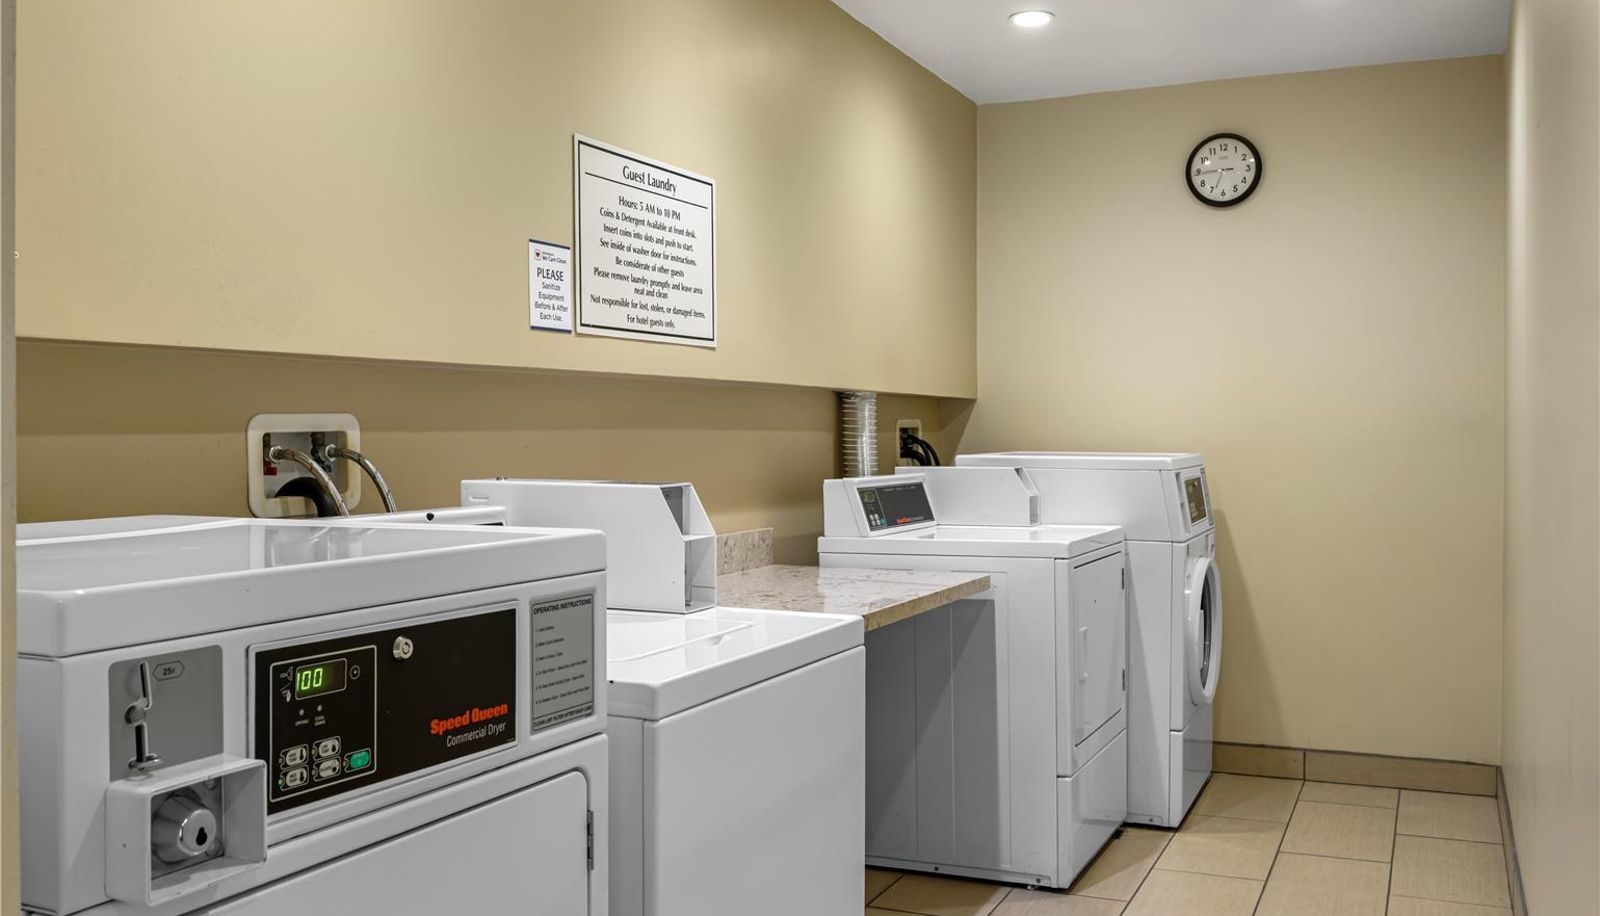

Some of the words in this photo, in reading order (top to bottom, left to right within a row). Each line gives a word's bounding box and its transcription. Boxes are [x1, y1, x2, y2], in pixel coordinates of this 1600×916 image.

[1209, 148, 1216, 156] 11
[1220, 144, 1228, 152] 12
[622, 166, 645, 184] Guest
[648, 173, 678, 196] Laundry
[618, 196, 638, 210] Hours:
[640, 202, 644, 211] 5
[645, 203, 655, 214] AM
[657, 207, 662, 216] to
[664, 209, 671, 219] 10
[672, 210, 681, 221] PM
[600, 207, 614, 218] Coins
[616, 211, 620, 220] &
[622, 212, 646, 227] Detergent
[647, 219, 667, 232] Available
[674, 225, 684, 236] front
[685, 228, 697, 239] desk.
[604, 223, 618, 235] Insert
[619, 228, 632, 238] coins
[633, 230, 643, 240] into
[644, 232, 654, 243] slots
[655, 236, 664, 245] and
[665, 239, 676, 249] push
[677, 241, 682, 250] to
[682, 243, 694, 252] start.
[600, 237, 609, 248] See
[610, 239, 625, 251] inside
[626, 243, 632, 252] of
[632, 246, 649, 256] washer
[650, 249, 661, 259] door
[670, 253, 697, 266] instructions.
[537, 267, 564, 282] PLEASE
[615, 256, 622, 265] Be
[623, 259, 650, 271] considerate
[651, 264, 657, 272] of
[657, 265, 670, 275] other
[670, 269, 685, 279] guests
[542, 282, 561, 292] Sanitize
[593, 266, 610, 279] Please
[611, 272, 629, 283] remove
[630, 274, 649, 288] laundry
[650, 280, 671, 291] promptly
[672, 282, 680, 291] and
[681, 282, 692, 293] leave
[538, 291, 565, 302] Equipment
[646, 289, 655, 297] and
[656, 290, 668, 299] clean
[535, 301, 551, 311] Before
[540, 312, 552, 320] Each
[590, 294, 601, 304] Not
[601, 297, 630, 309] responsible
[639, 301, 649, 311] lost,
[650, 303, 665, 313] stolen,
[672, 305, 692, 319] damaged
[693, 309, 706, 319] items.
[627, 314, 635, 323] For
[636, 315, 649, 325] hotel
[650, 319, 664, 329] guests
[665, 319, 676, 330] only.
[533, 603, 560, 615] OPERATING
[560, 598, 592, 610] INSTRUCTIONS
[296, 667, 323, 692] 100
[430, 710, 470, 736] Speed
[471, 703, 508, 722] Queen
[446, 724, 487, 747] Commercial
[488, 721, 506, 736] Dryer
